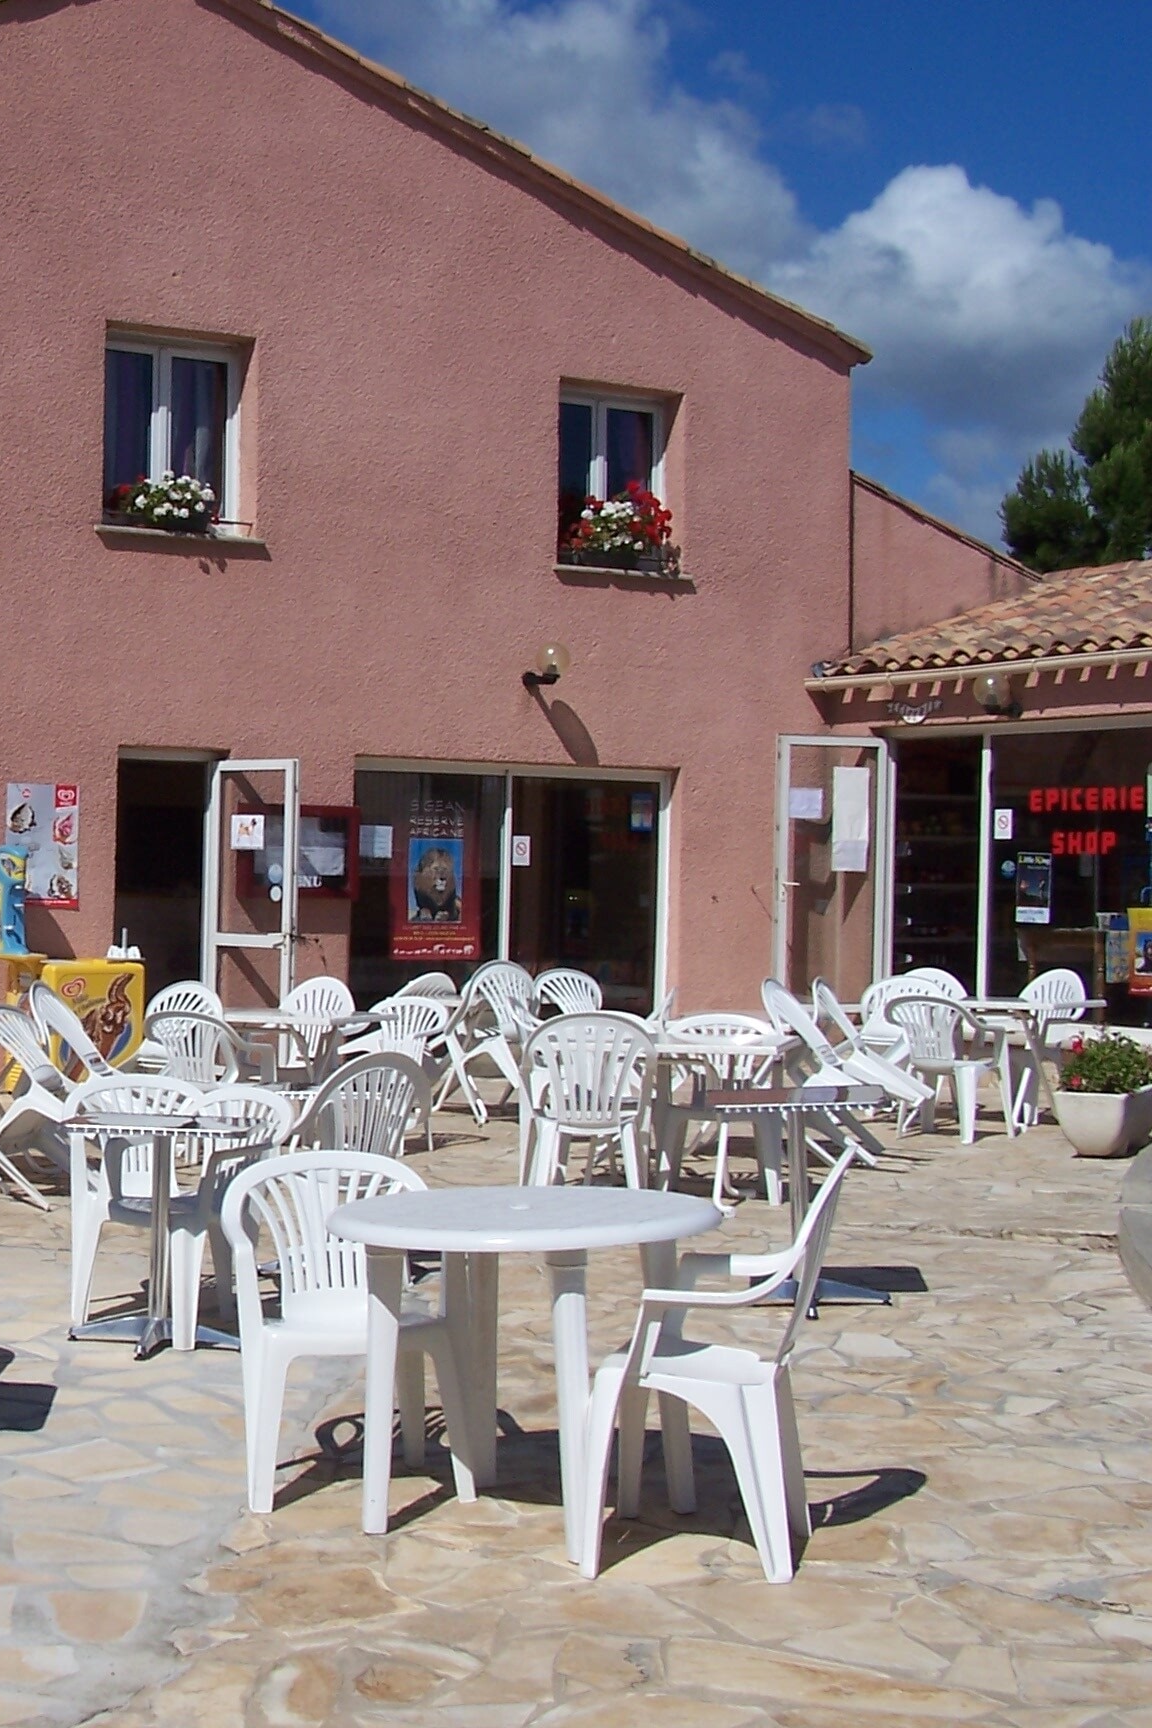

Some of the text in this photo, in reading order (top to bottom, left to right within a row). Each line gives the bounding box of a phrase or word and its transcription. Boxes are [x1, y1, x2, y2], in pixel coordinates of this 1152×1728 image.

[409, 800, 465, 812] SGEAN
[1029, 786, 1145, 812] EPICERIE
[1051, 831, 1116, 855] SHOP
